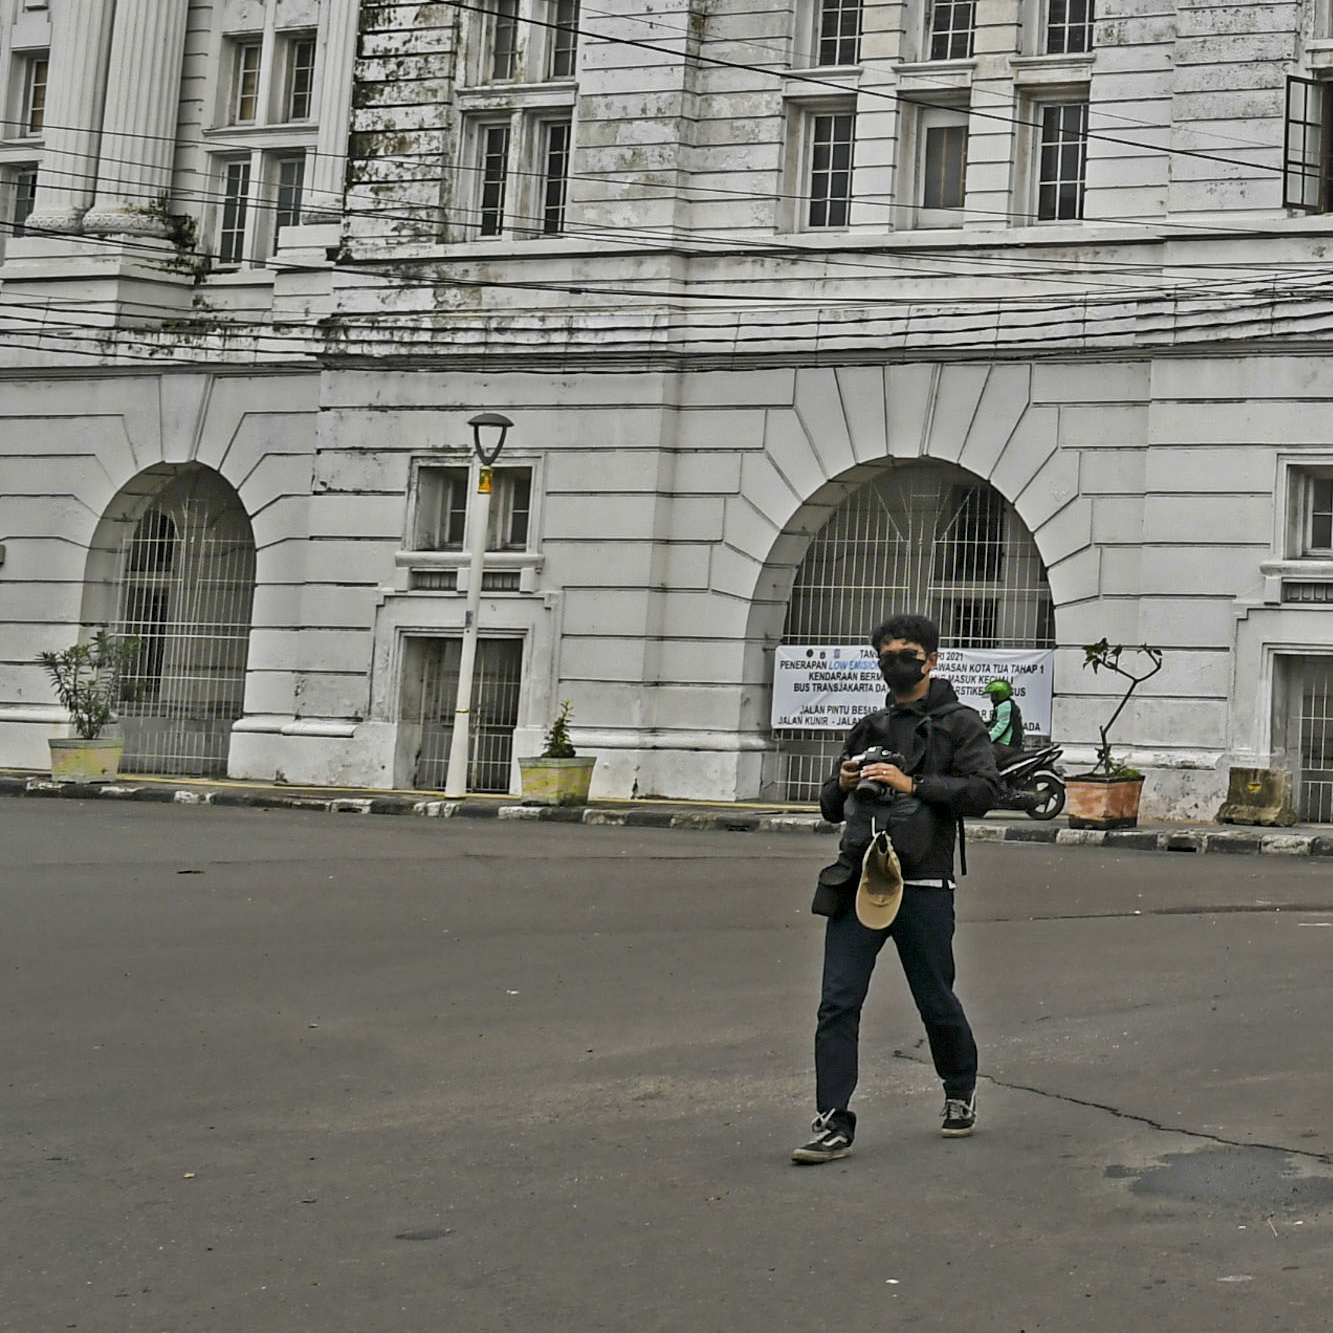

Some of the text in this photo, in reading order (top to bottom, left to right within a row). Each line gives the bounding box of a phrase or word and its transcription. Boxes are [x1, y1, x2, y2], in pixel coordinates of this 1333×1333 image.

[946, 652, 964, 661] 2021
[779, 660, 827, 670] PENERAPAN
[828, 660, 848, 670] LOW
[968, 664, 991, 673] KOTA
[992, 664, 1010, 673] TUA
[1010, 664, 1038, 674] TAHAP
[1040, 664, 1045, 674] 1
[808, 671, 858, 681] KENDARAAN
[793, 682, 810, 692] BUS
[812, 682, 874, 692] TRANSJAKARTA
[799, 705, 825, 715] JALAN
[826, 705, 850, 715] PINTU
[778, 716, 803, 725] JALAN
[804, 716, 829, 725] KUNIR
